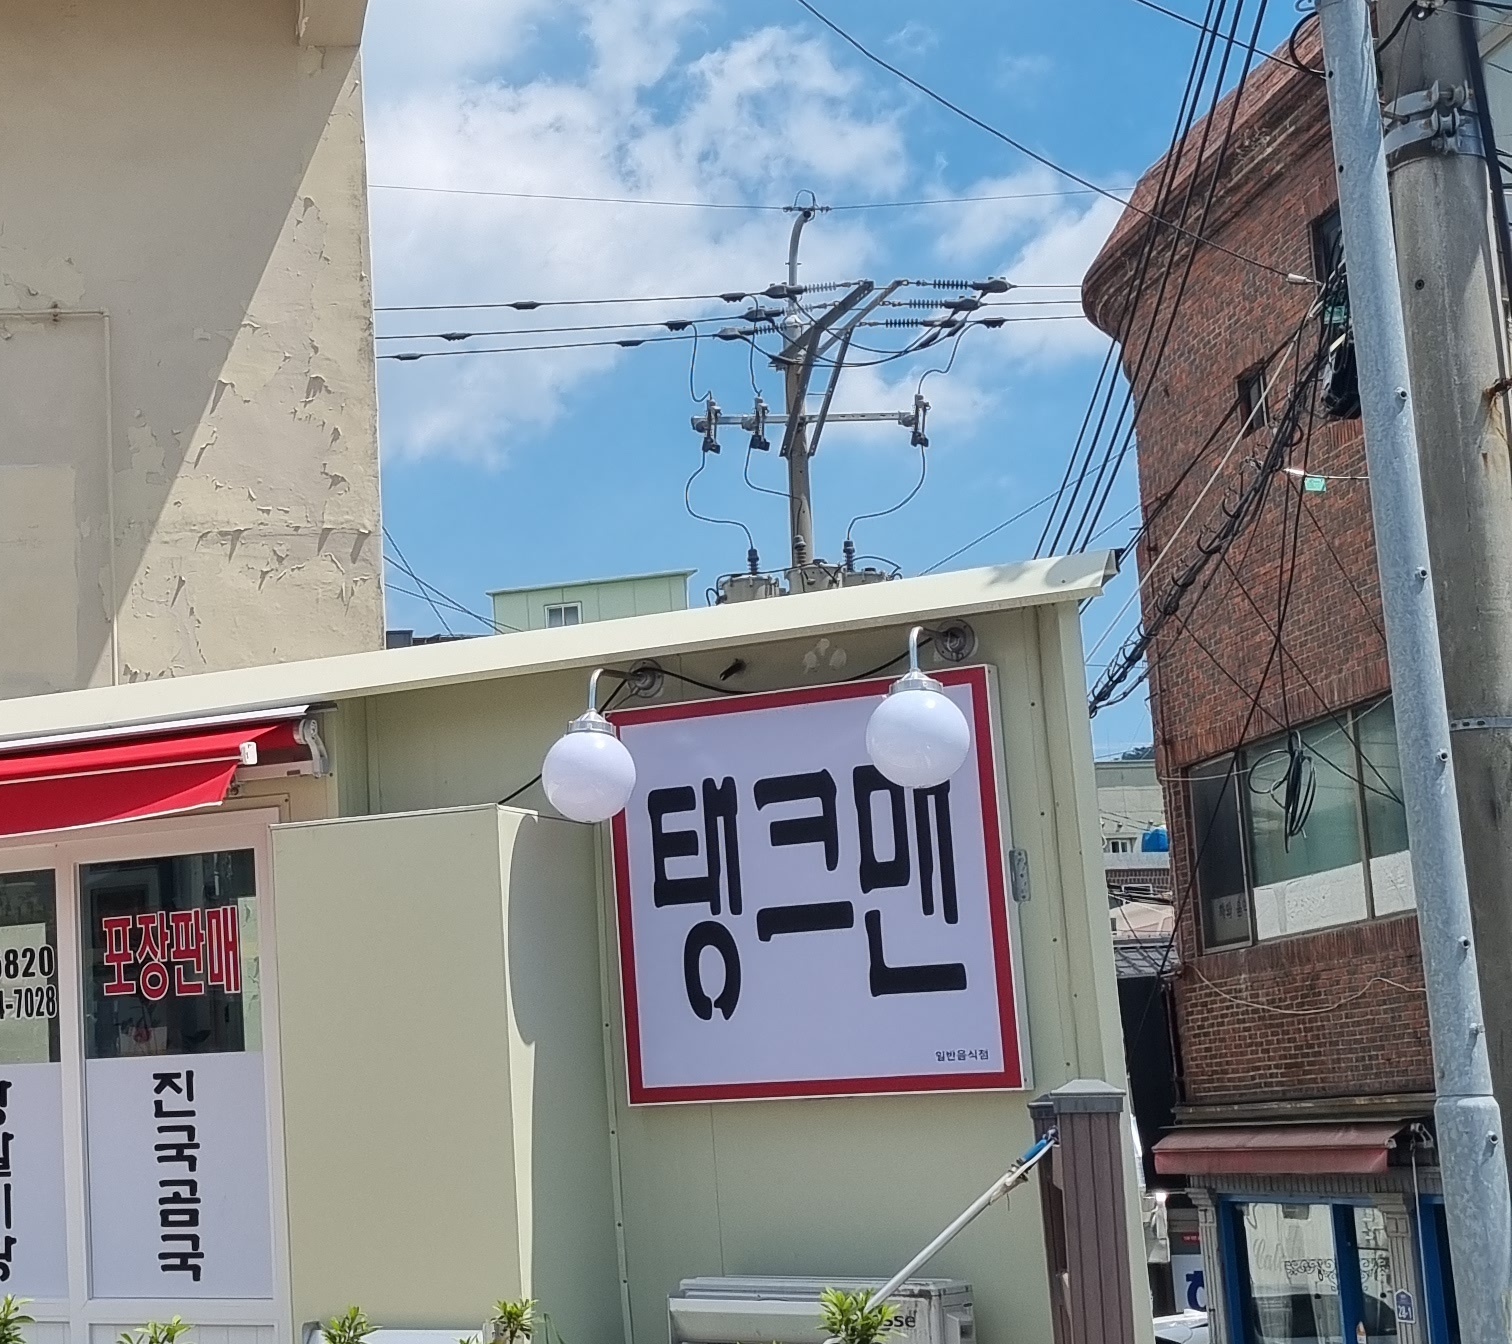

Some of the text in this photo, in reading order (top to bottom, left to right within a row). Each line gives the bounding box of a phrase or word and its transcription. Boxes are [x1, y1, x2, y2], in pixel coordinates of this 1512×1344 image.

[102, 904, 242, 1001] 포장판매
[647, 762, 968, 1021] 탱크맨
[151, 1069, 206, 1283] 진국곰국
